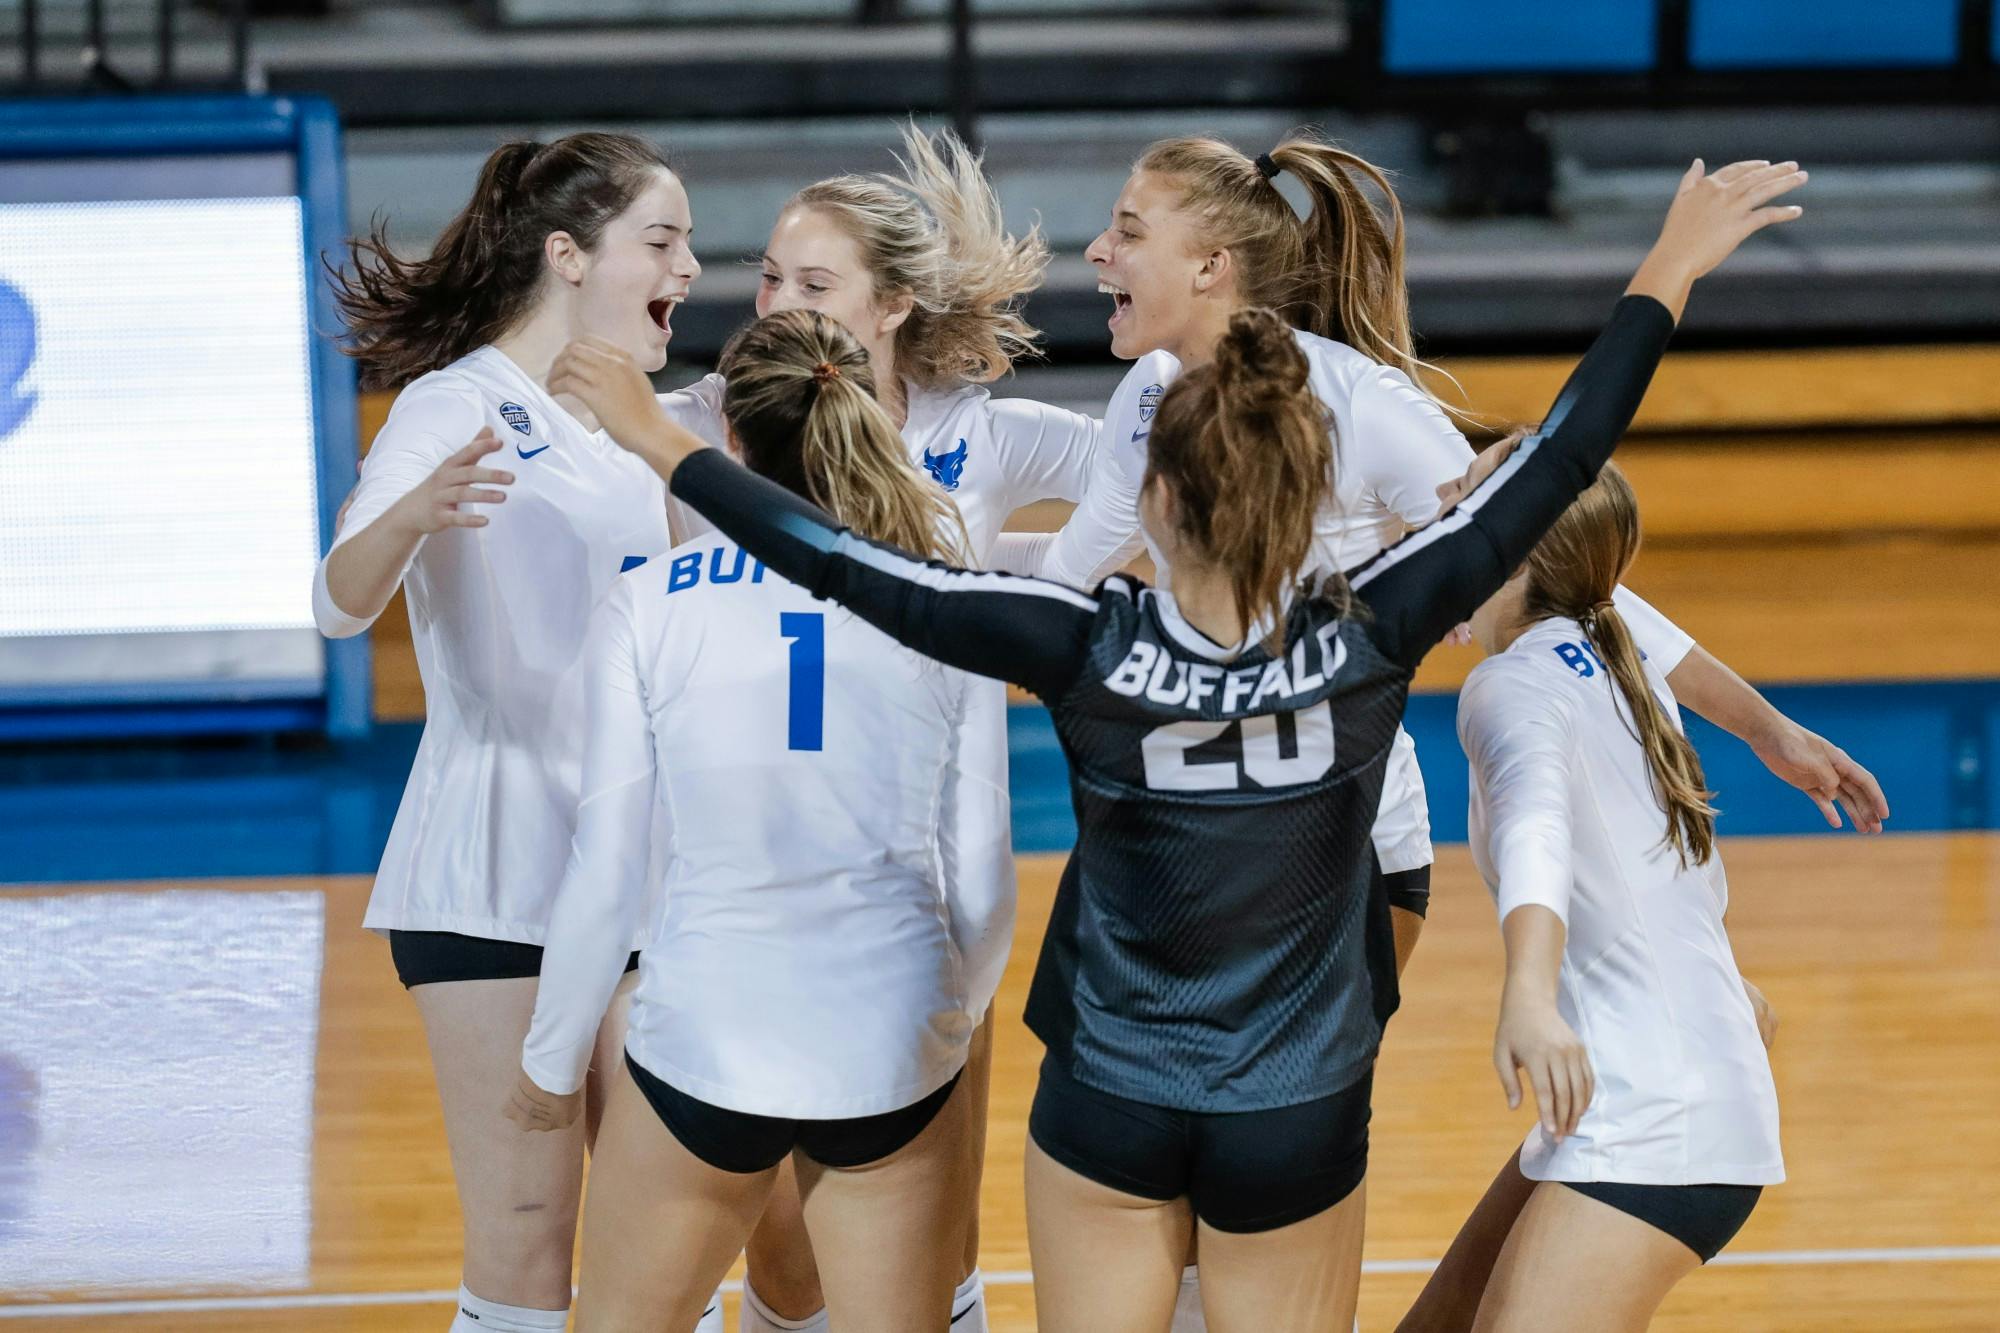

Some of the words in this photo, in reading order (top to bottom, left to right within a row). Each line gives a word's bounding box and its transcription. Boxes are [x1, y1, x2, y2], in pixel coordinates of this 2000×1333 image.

[503, 412, 530, 424] MAC
[780, 612, 825, 751] 1
[1103, 619, 1348, 713] BUFFALO
[1141, 699, 1336, 791] 20
